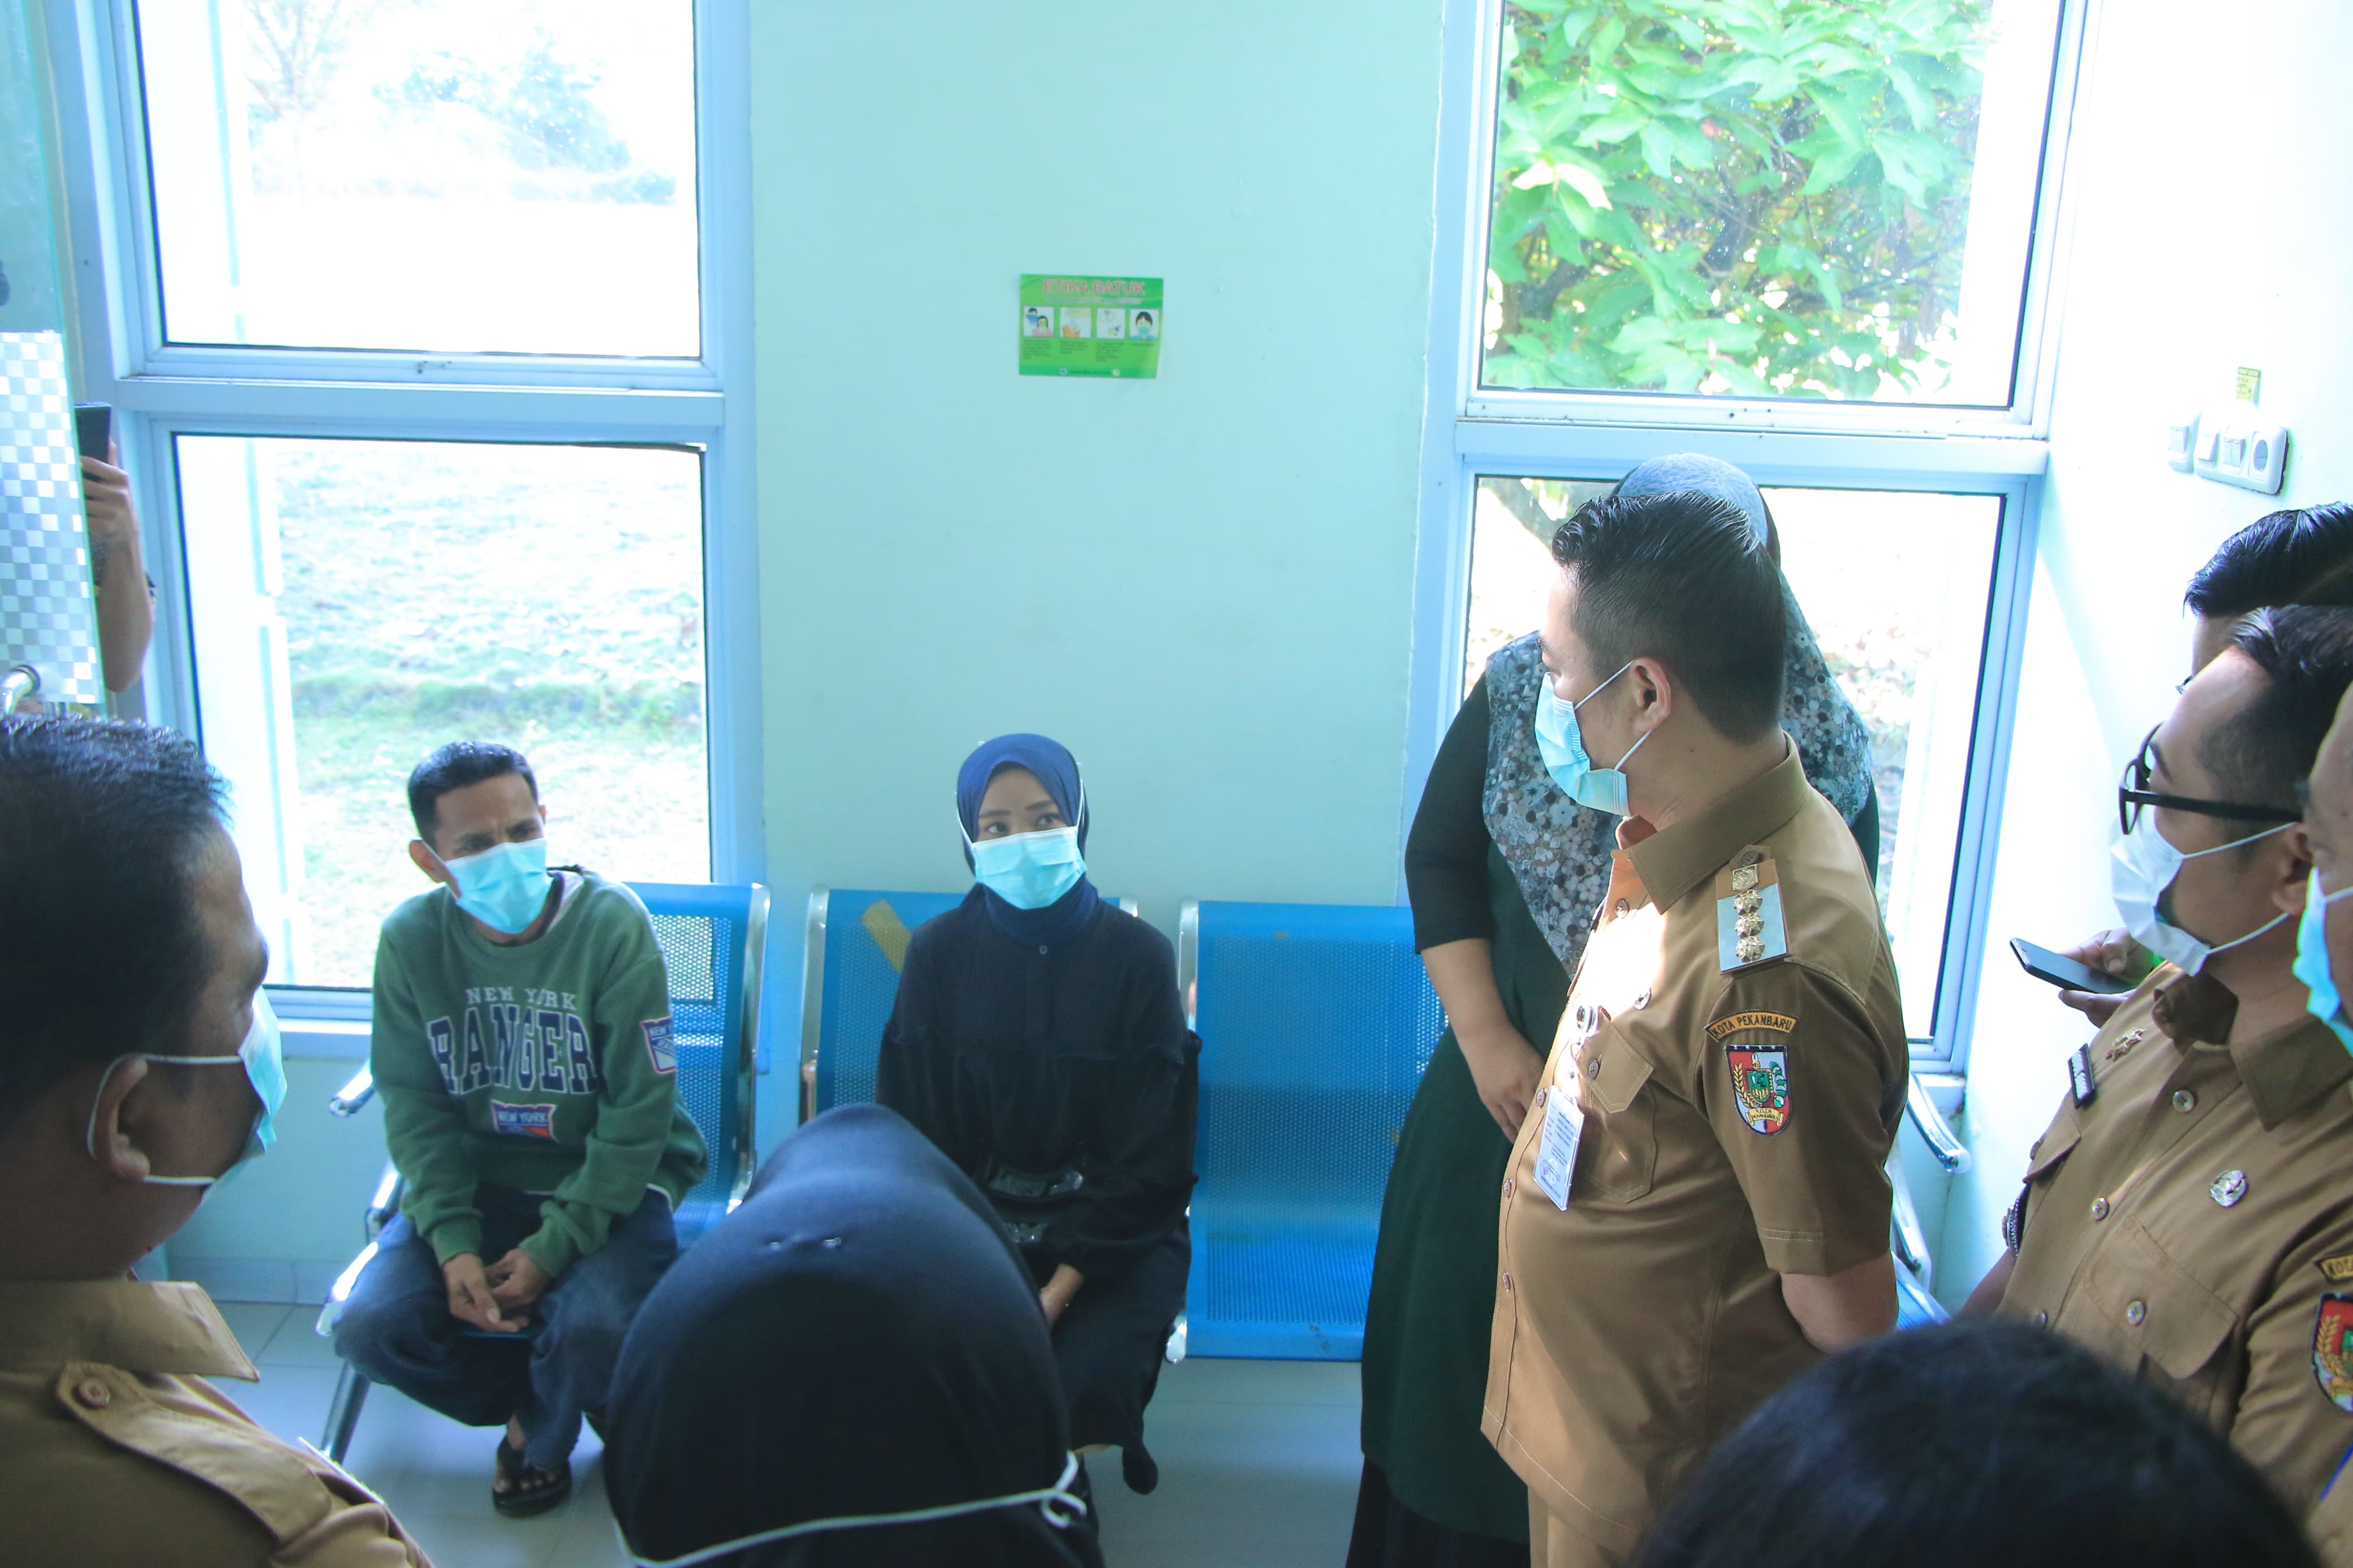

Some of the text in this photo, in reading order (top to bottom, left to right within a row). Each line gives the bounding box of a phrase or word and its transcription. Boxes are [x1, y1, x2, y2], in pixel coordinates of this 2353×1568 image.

[1044, 279, 1146, 295] ETIKA BATUK
[465, 987, 514, 1005] NEW
[1712, 1014, 1792, 1037] KOTA PEKANBARU
[498, 1111, 548, 1123] NEW YORK
